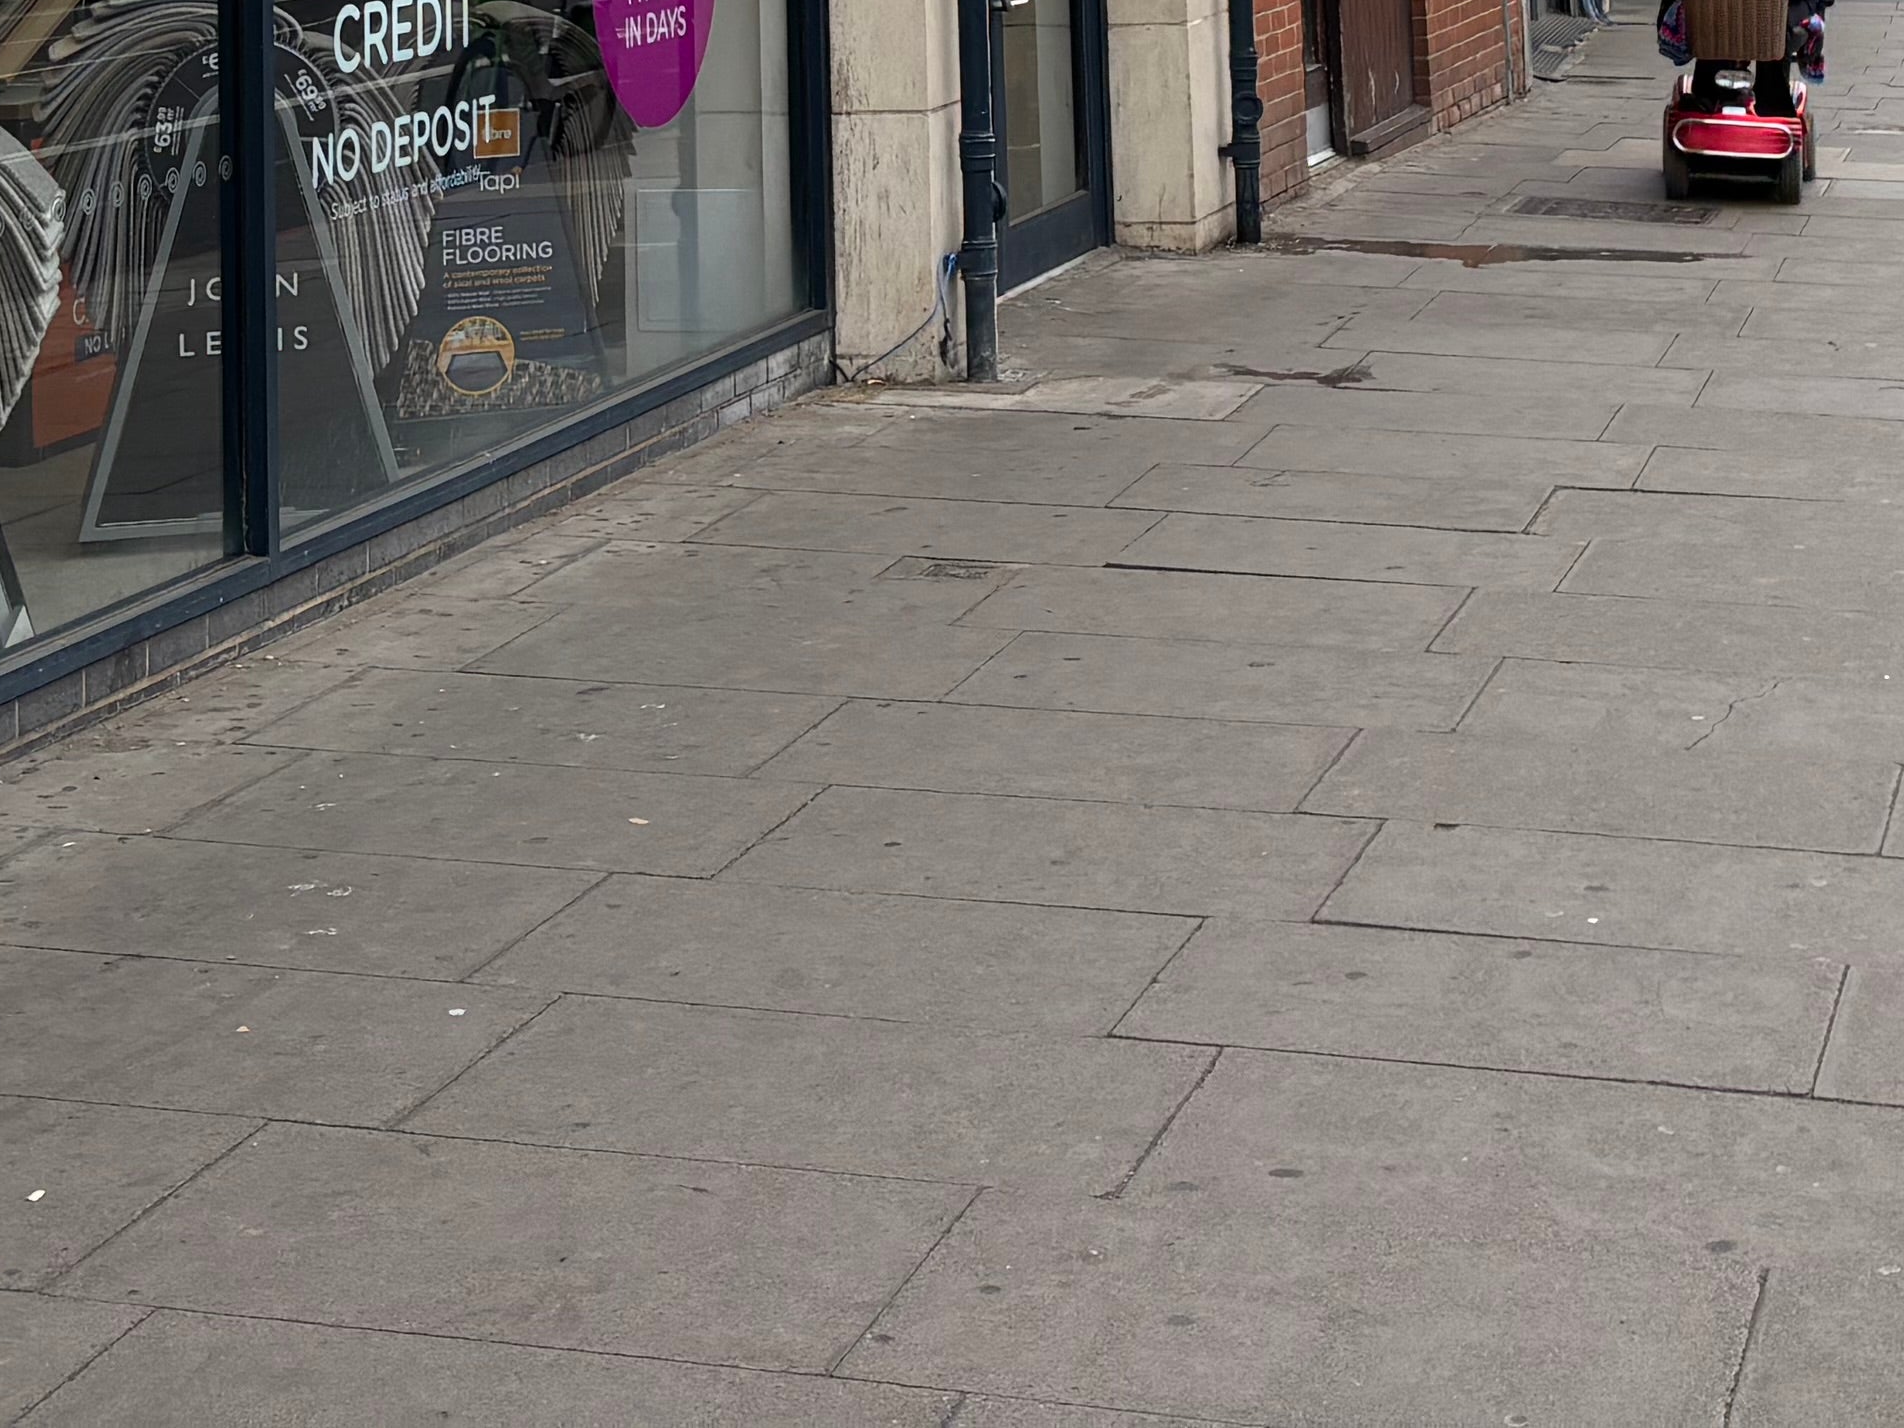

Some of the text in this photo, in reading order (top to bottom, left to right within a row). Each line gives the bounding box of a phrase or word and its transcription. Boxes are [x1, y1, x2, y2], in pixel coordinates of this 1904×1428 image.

[625, 4, 687, 49] IN DAYS
[312, 94, 496, 189] NO DEPOSIT
[479, 166, 523, 194] Tapi
[331, 195, 367, 220] Subject
[412, 178, 428, 198] and
[442, 226, 504, 247] FIBRE
[443, 242, 553, 266] FLOORING
[186, 271, 299, 307] JON
[179, 325, 309, 358] LEIS
